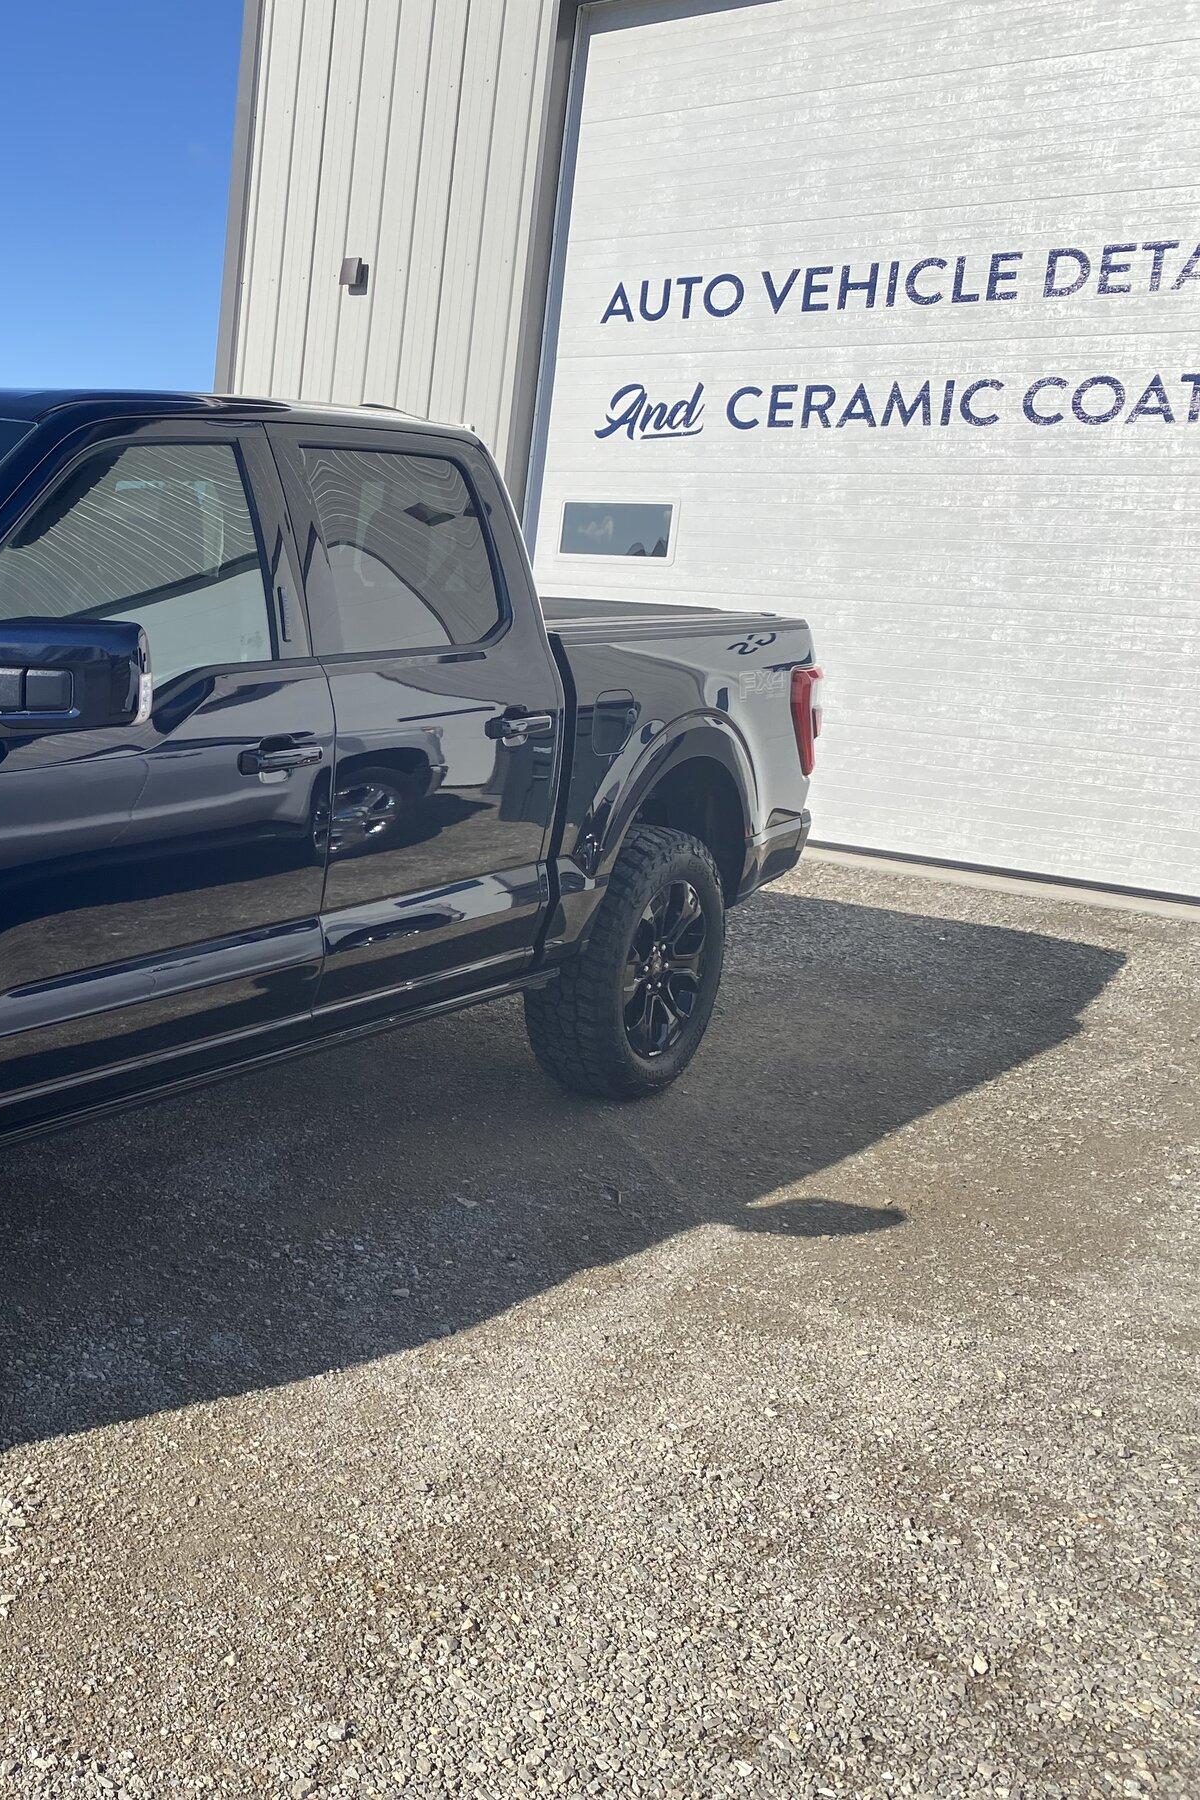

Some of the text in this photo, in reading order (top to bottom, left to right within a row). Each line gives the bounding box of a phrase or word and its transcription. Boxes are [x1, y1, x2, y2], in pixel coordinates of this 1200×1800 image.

[600, 272, 745, 323] AUTO
[762, 251, 1022, 314] VEHICLE
[594, 382, 704, 440] And
[726, 379, 1004, 430] CERAMIC
